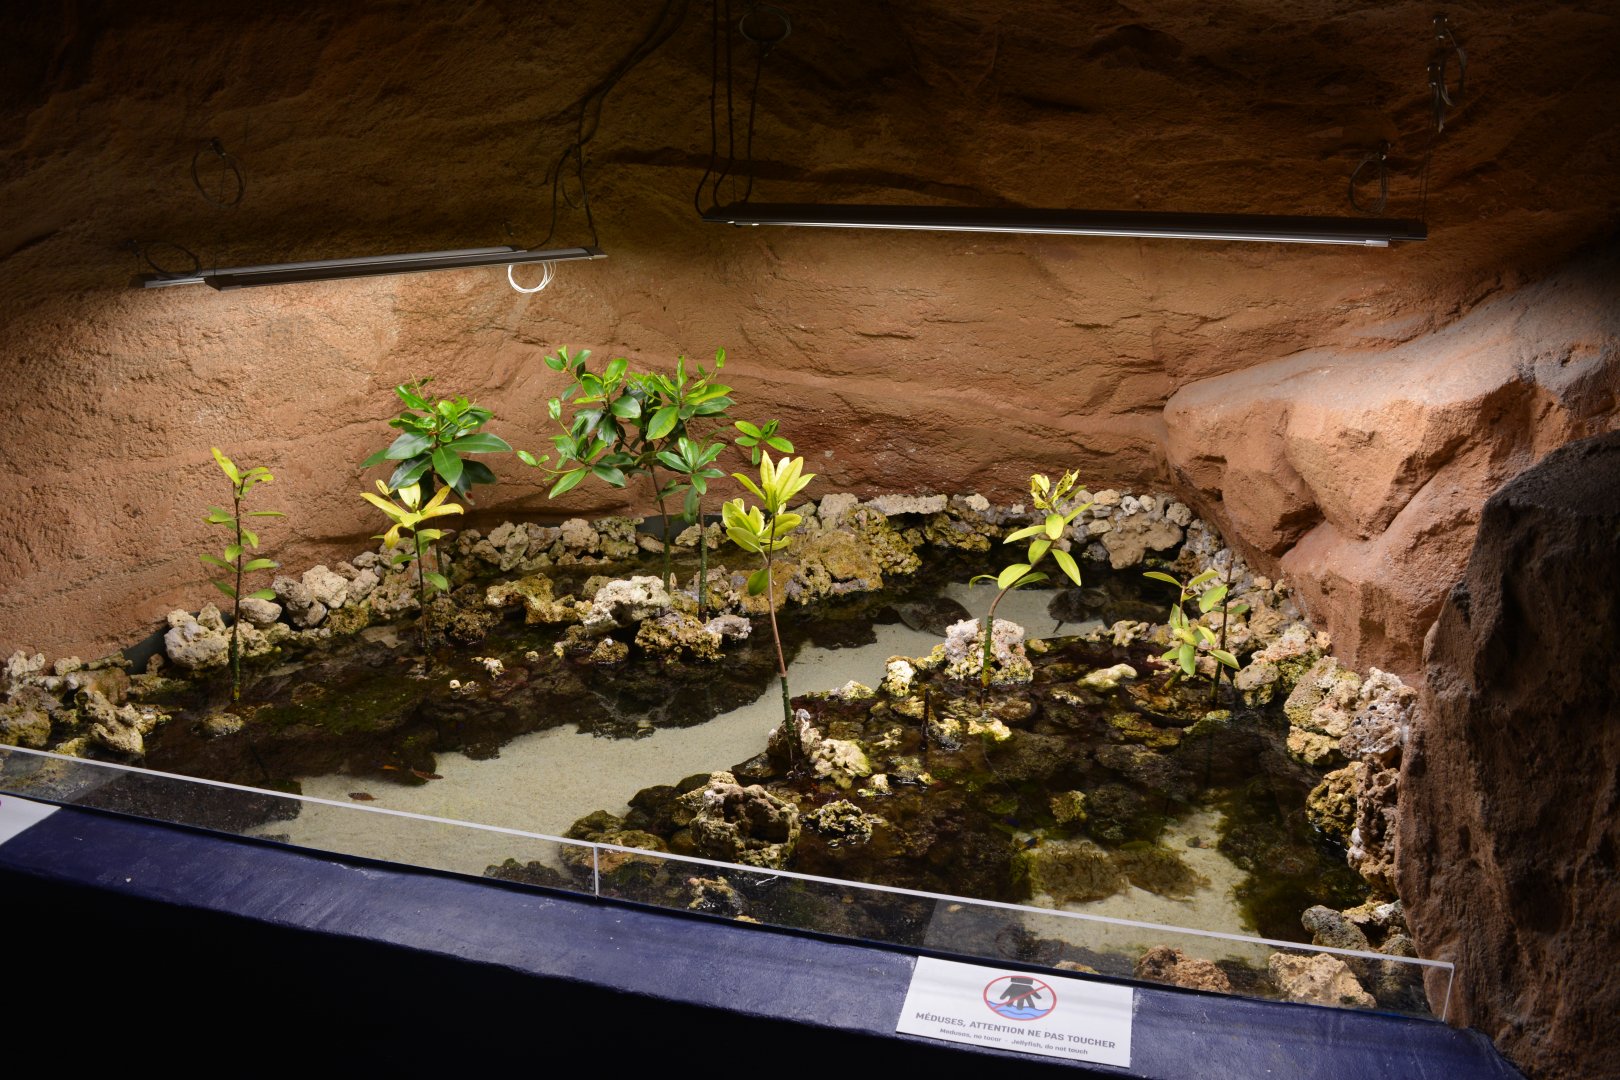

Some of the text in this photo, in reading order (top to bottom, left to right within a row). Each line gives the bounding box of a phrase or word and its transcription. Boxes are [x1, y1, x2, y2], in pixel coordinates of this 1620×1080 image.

[915, 1012, 1117, 1049] MÉDUSES, ATTENTION NE PAS TOUCHER
[1011, 1039, 1043, 1049] Jellyfish,
[1068, 1047, 1088, 1055] touch
